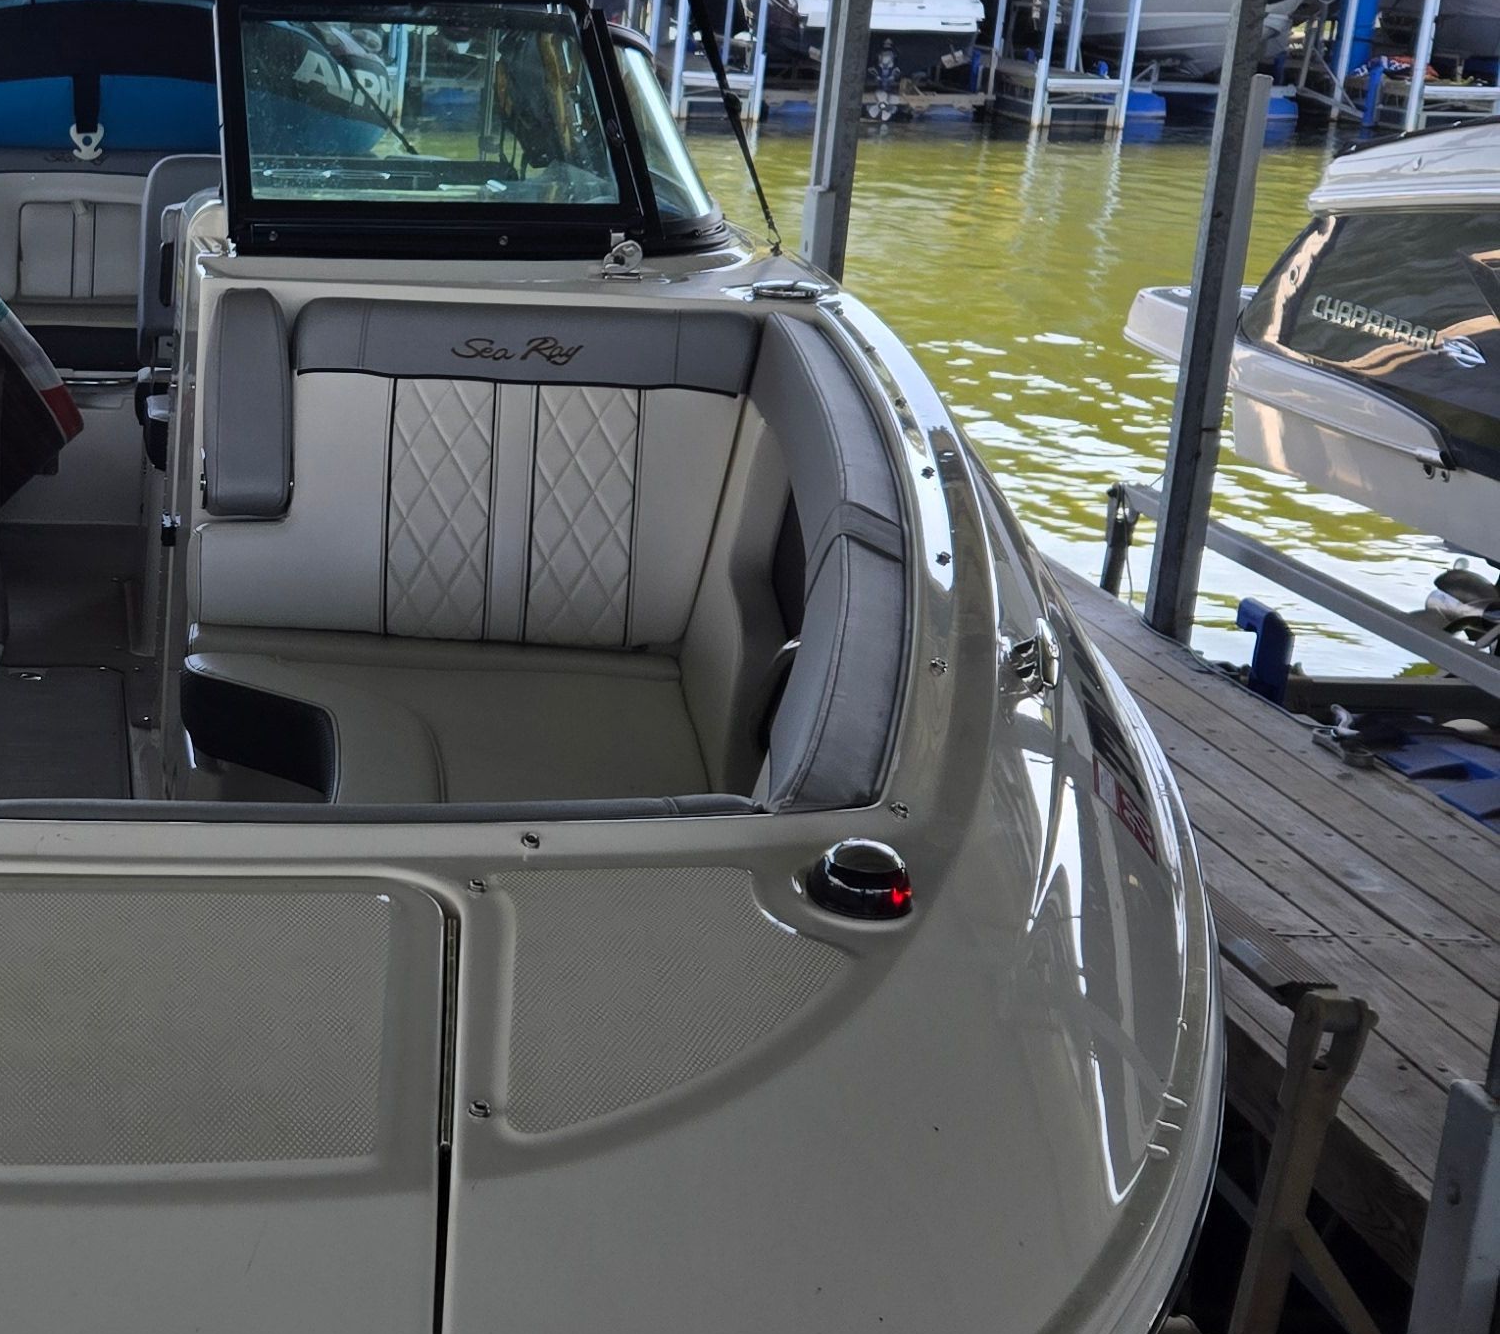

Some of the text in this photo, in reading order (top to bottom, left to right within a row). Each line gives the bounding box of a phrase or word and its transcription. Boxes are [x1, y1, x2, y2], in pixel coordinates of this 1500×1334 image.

[1311, 293, 1440, 353] CHAPARRAL
[451, 336, 584, 366] Sea Ray
